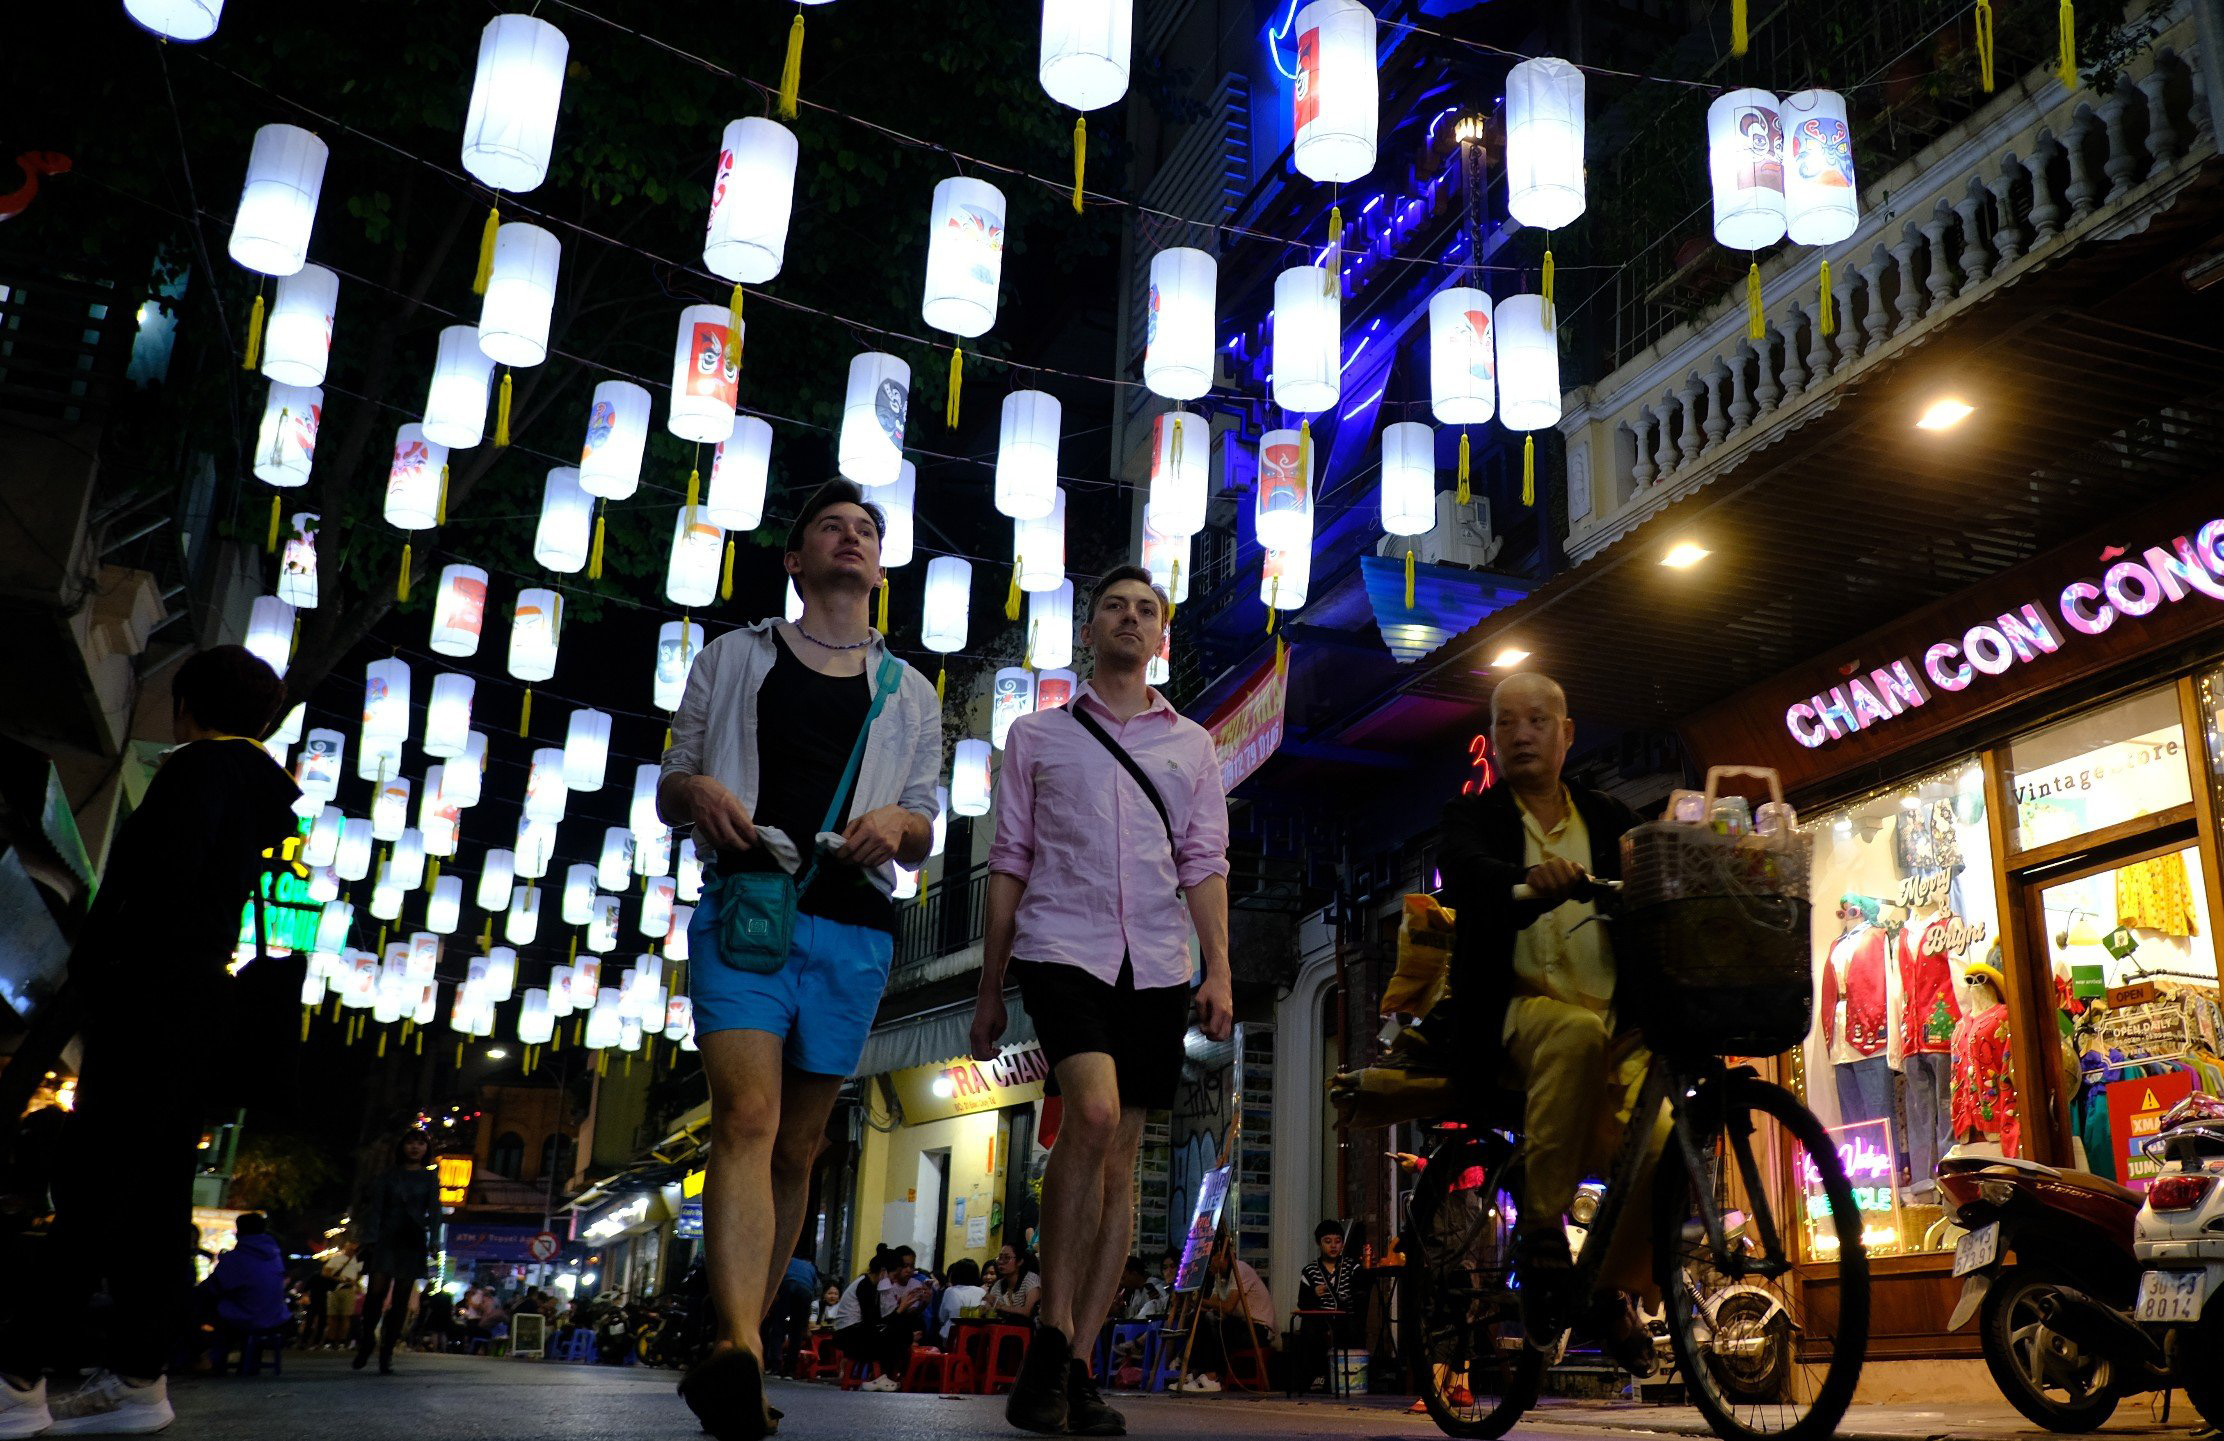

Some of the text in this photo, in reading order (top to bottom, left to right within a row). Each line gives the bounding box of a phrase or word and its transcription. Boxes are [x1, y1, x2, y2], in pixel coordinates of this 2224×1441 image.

[1924, 603, 2059, 692] CON
[2011, 740, 2179, 805] Vintage tore
[1895, 866, 1952, 908] Merry
[1922, 921, 1986, 956] Bright
[2115, 988, 2145, 1003] OPEN
[2113, 1017, 2173, 1037] OPEN DAILY
